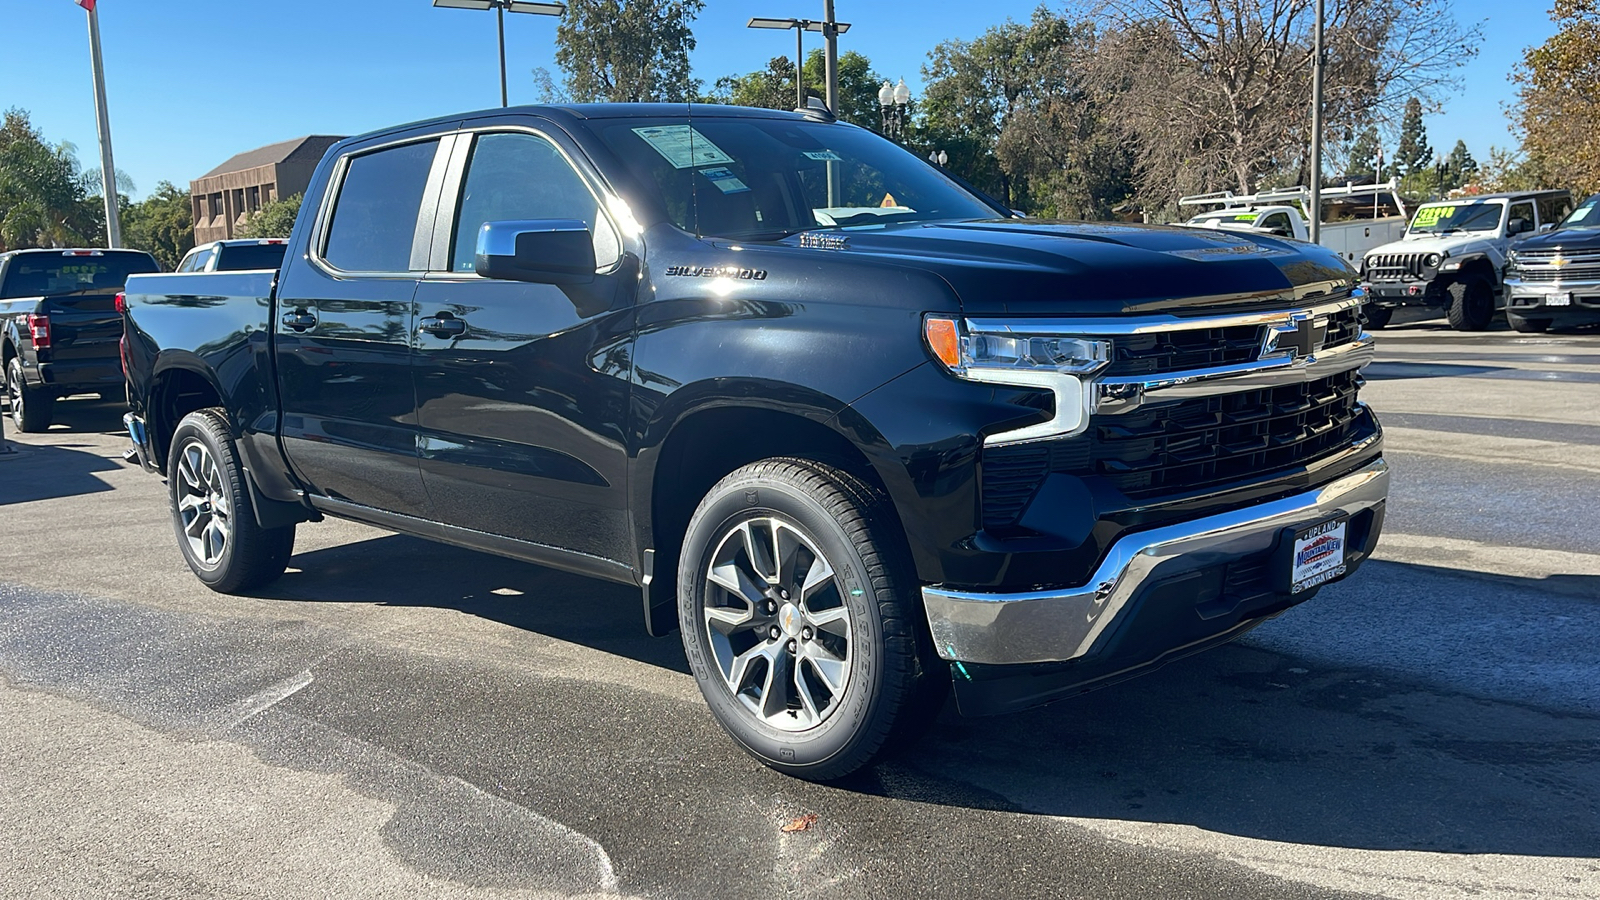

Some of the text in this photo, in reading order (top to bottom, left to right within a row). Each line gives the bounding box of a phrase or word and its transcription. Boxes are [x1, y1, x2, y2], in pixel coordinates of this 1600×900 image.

[665, 265, 768, 281] SILVERADO
[1309, 521, 1336, 538] UPLAND
[1297, 539, 1341, 569] MOUNTAIN VIEW
[682, 570, 708, 681] GENERAL
